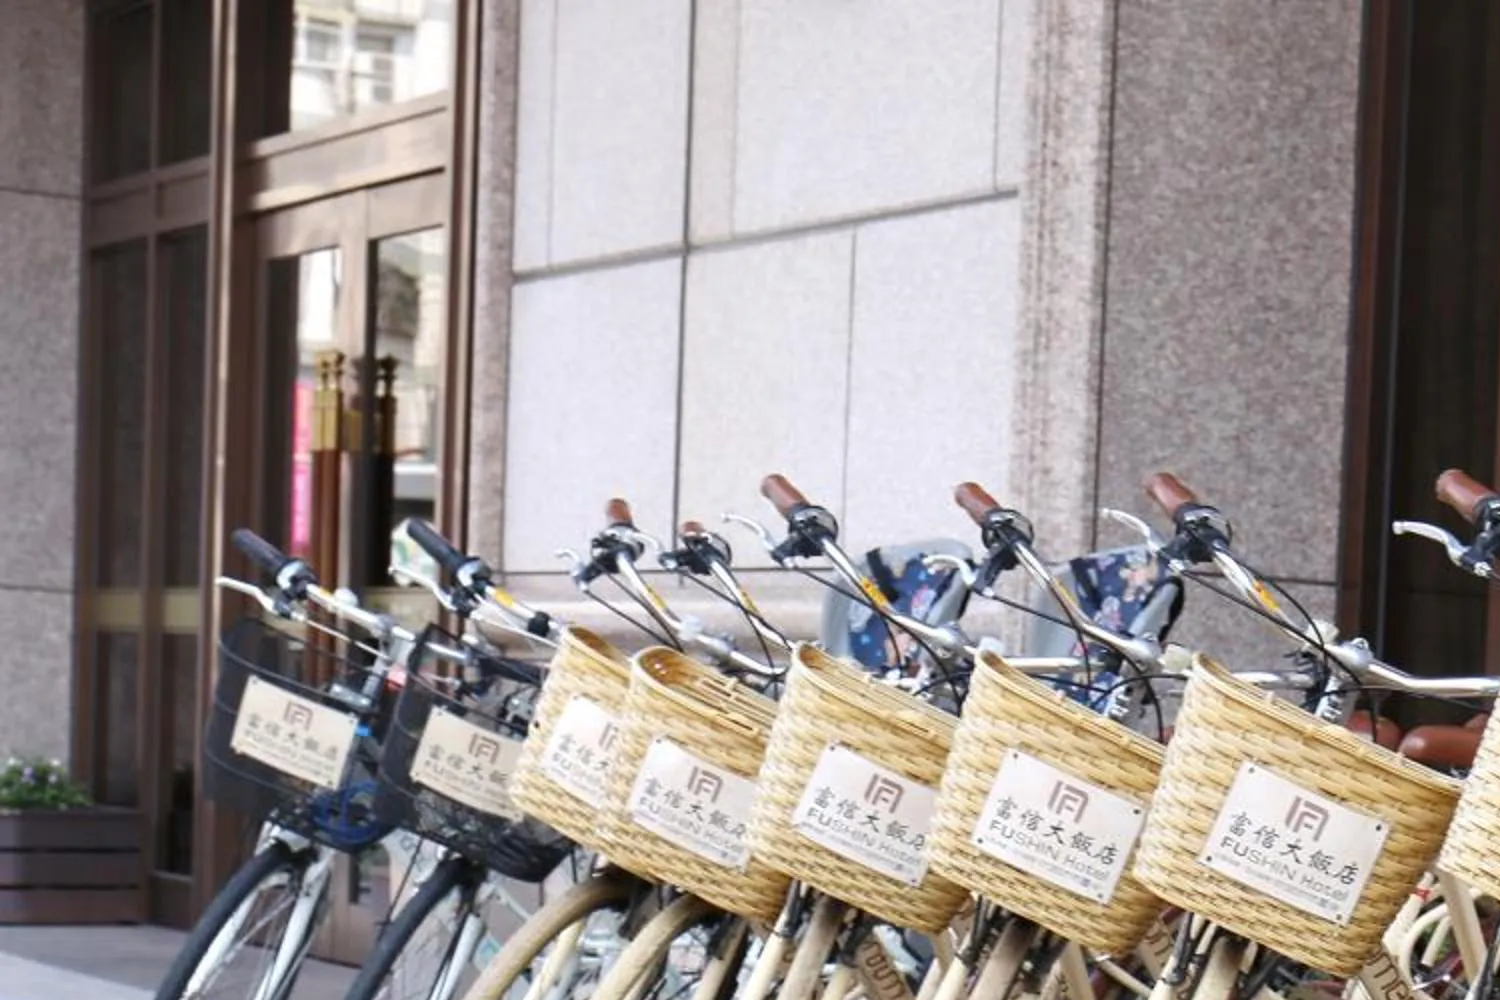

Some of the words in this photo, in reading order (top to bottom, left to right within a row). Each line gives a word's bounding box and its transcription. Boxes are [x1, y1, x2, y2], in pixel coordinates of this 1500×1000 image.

[989, 819, 1059, 860] FUSHIN
[996, 796, 1120, 865] 富信大飯店
[1219, 836, 1297, 880] FUSHIN
[1230, 811, 1359, 885] 富信大飯店
